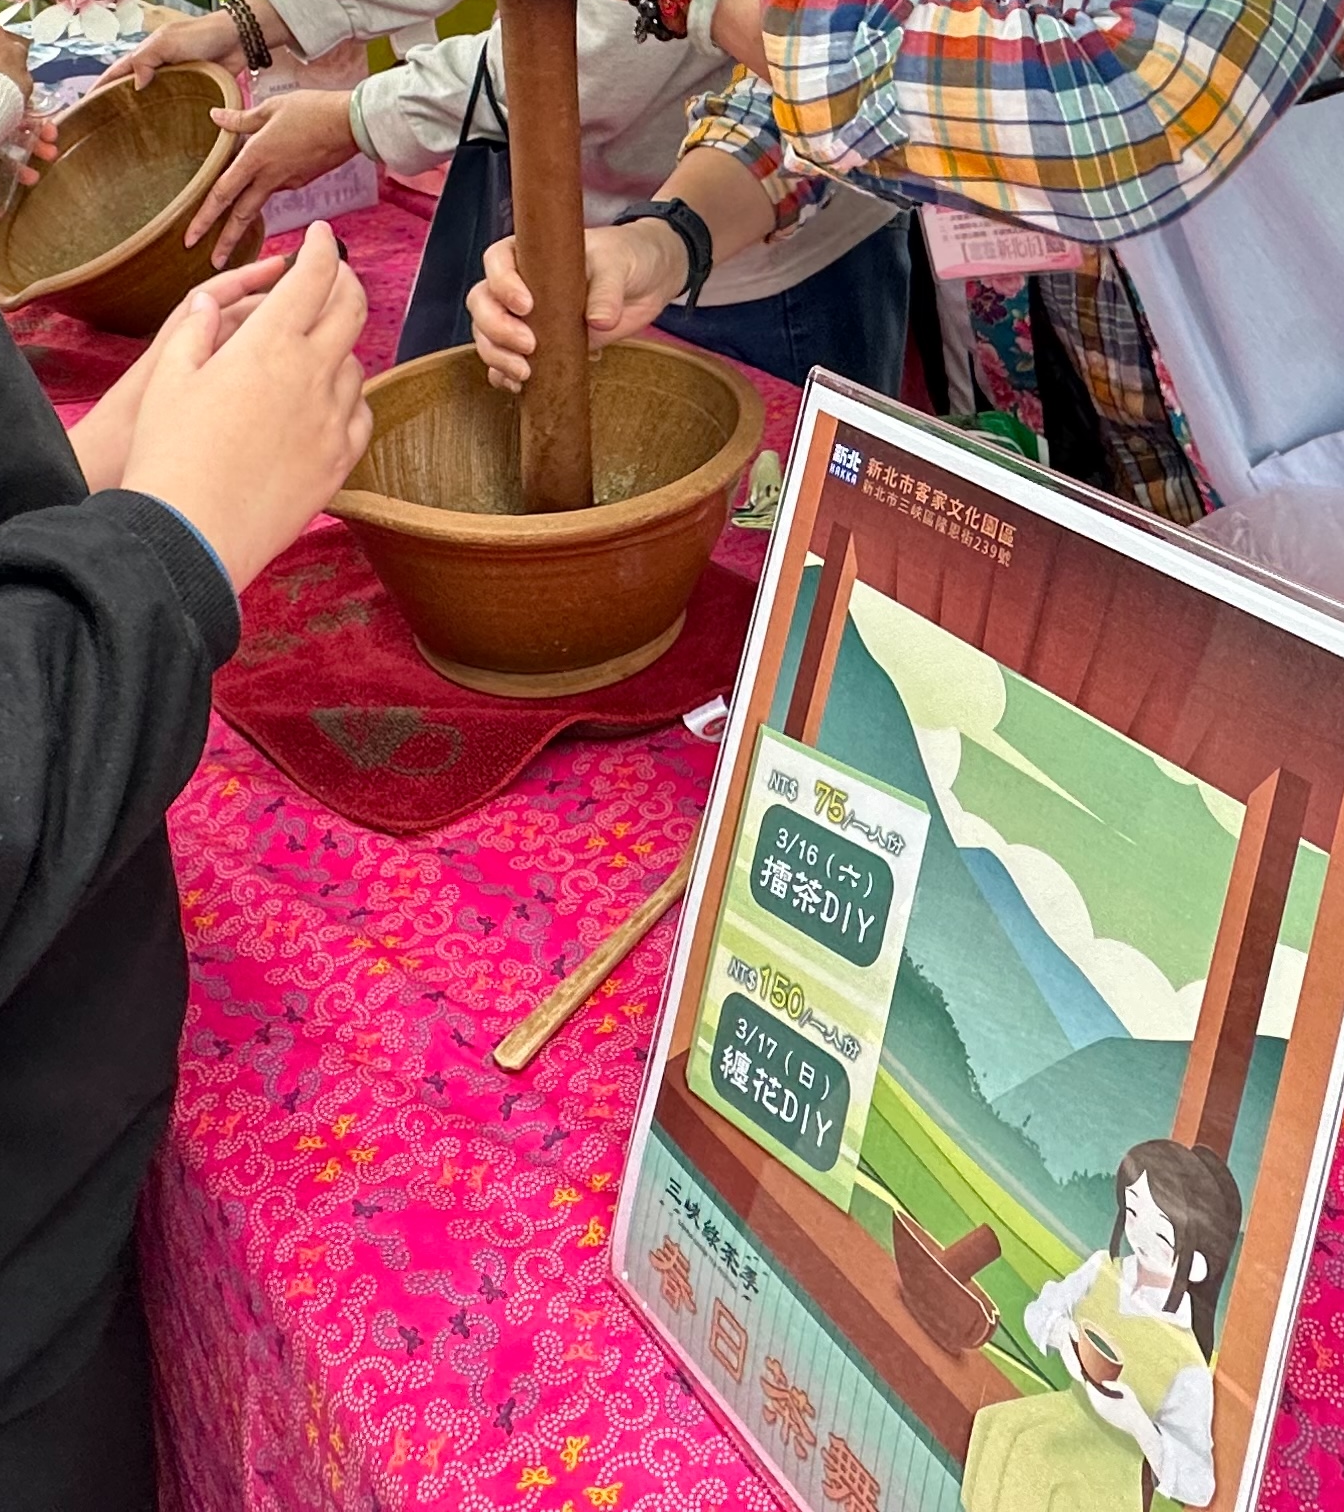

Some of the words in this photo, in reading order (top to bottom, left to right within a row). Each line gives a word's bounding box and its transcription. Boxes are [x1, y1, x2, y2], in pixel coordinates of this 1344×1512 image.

[829, 463, 858, 486] HAKKA
[832, 443, 862, 472] 新北
[866, 457, 1017, 548] 新北市客家文化園區
[768, 769, 799, 803] NT$
[759, 854, 876, 944] 擂茶DIY
[719, 1044, 834, 1148] 纏花DIY
